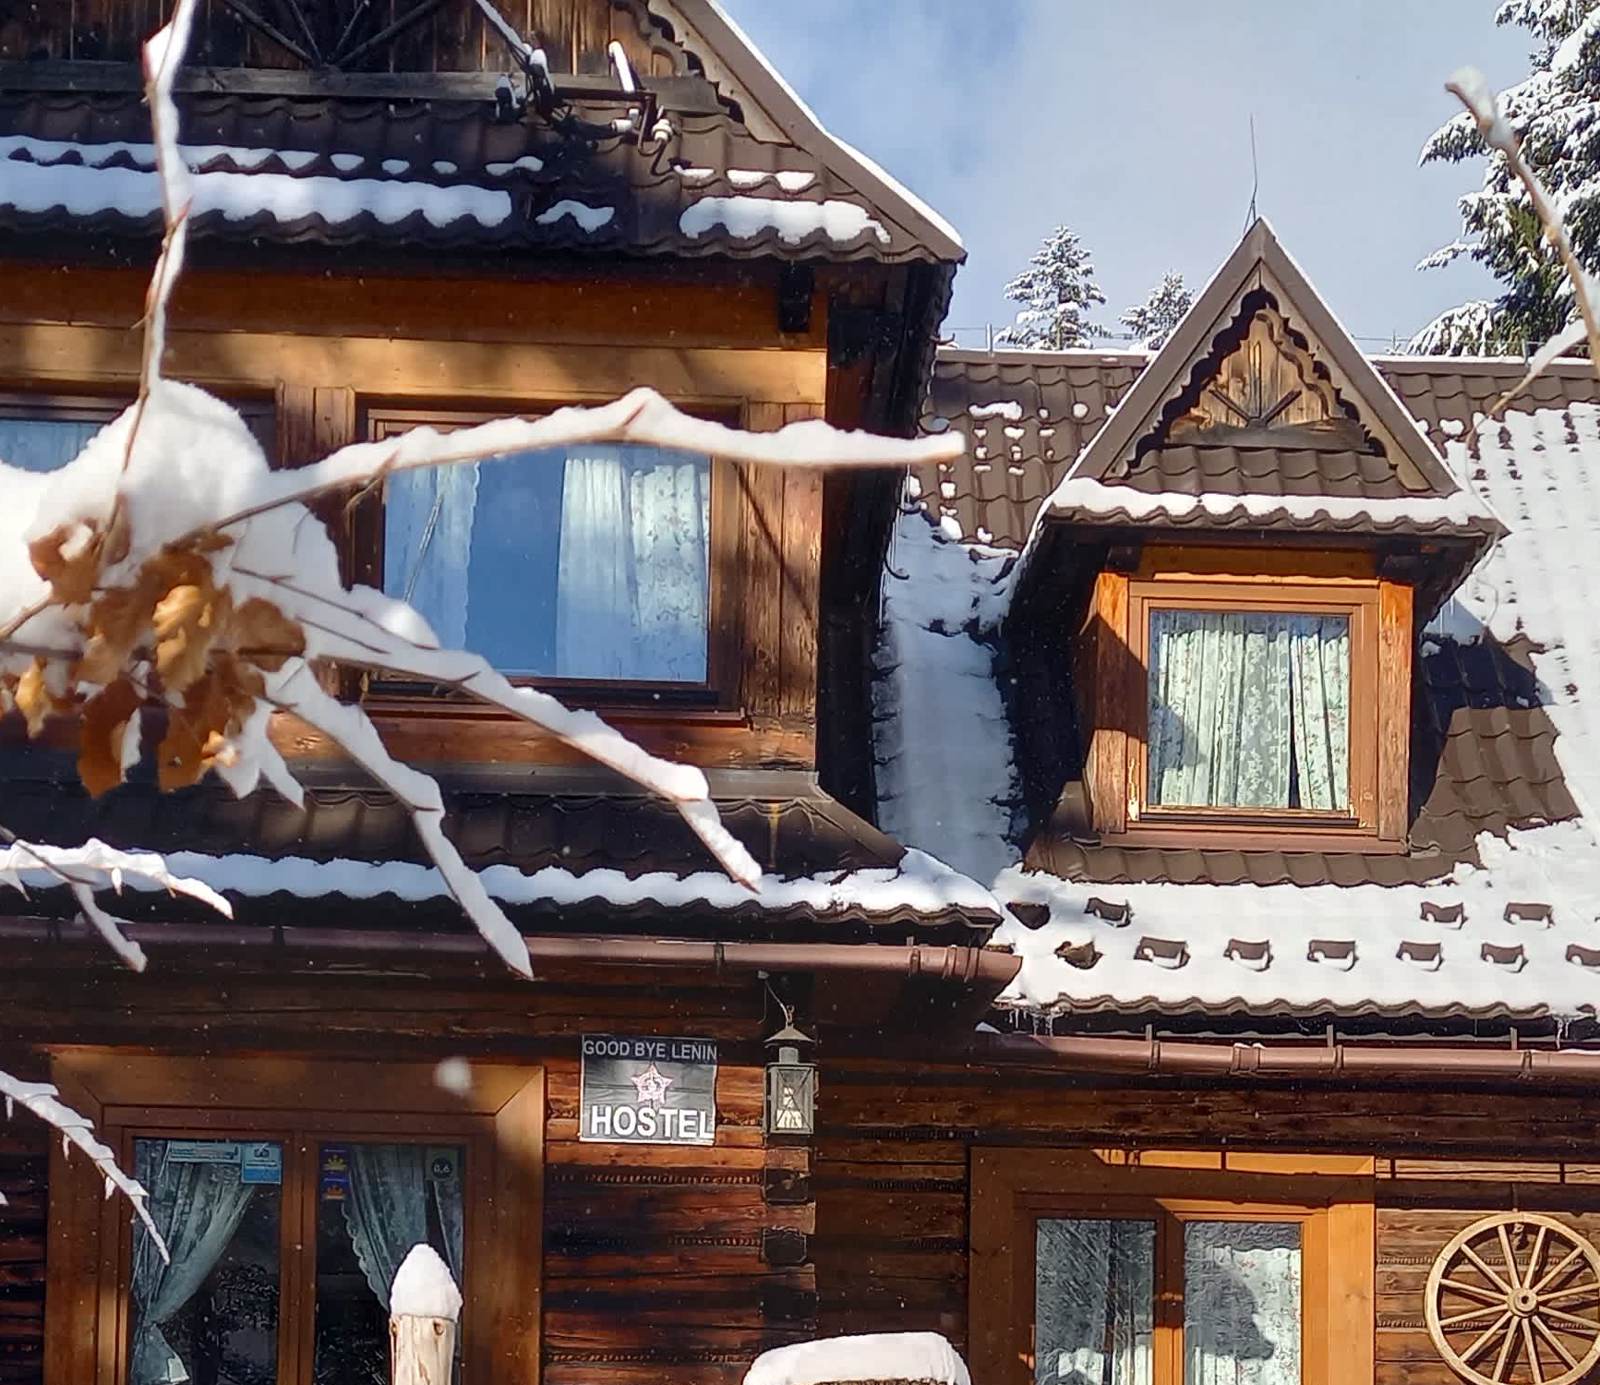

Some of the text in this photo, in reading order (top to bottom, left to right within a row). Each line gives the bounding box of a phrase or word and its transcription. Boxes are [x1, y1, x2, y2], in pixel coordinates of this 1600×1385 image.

[583, 1040, 630, 1056] GOOD
[671, 1043, 717, 1061] LENIN
[591, 1105, 713, 1139] HOSTEL
